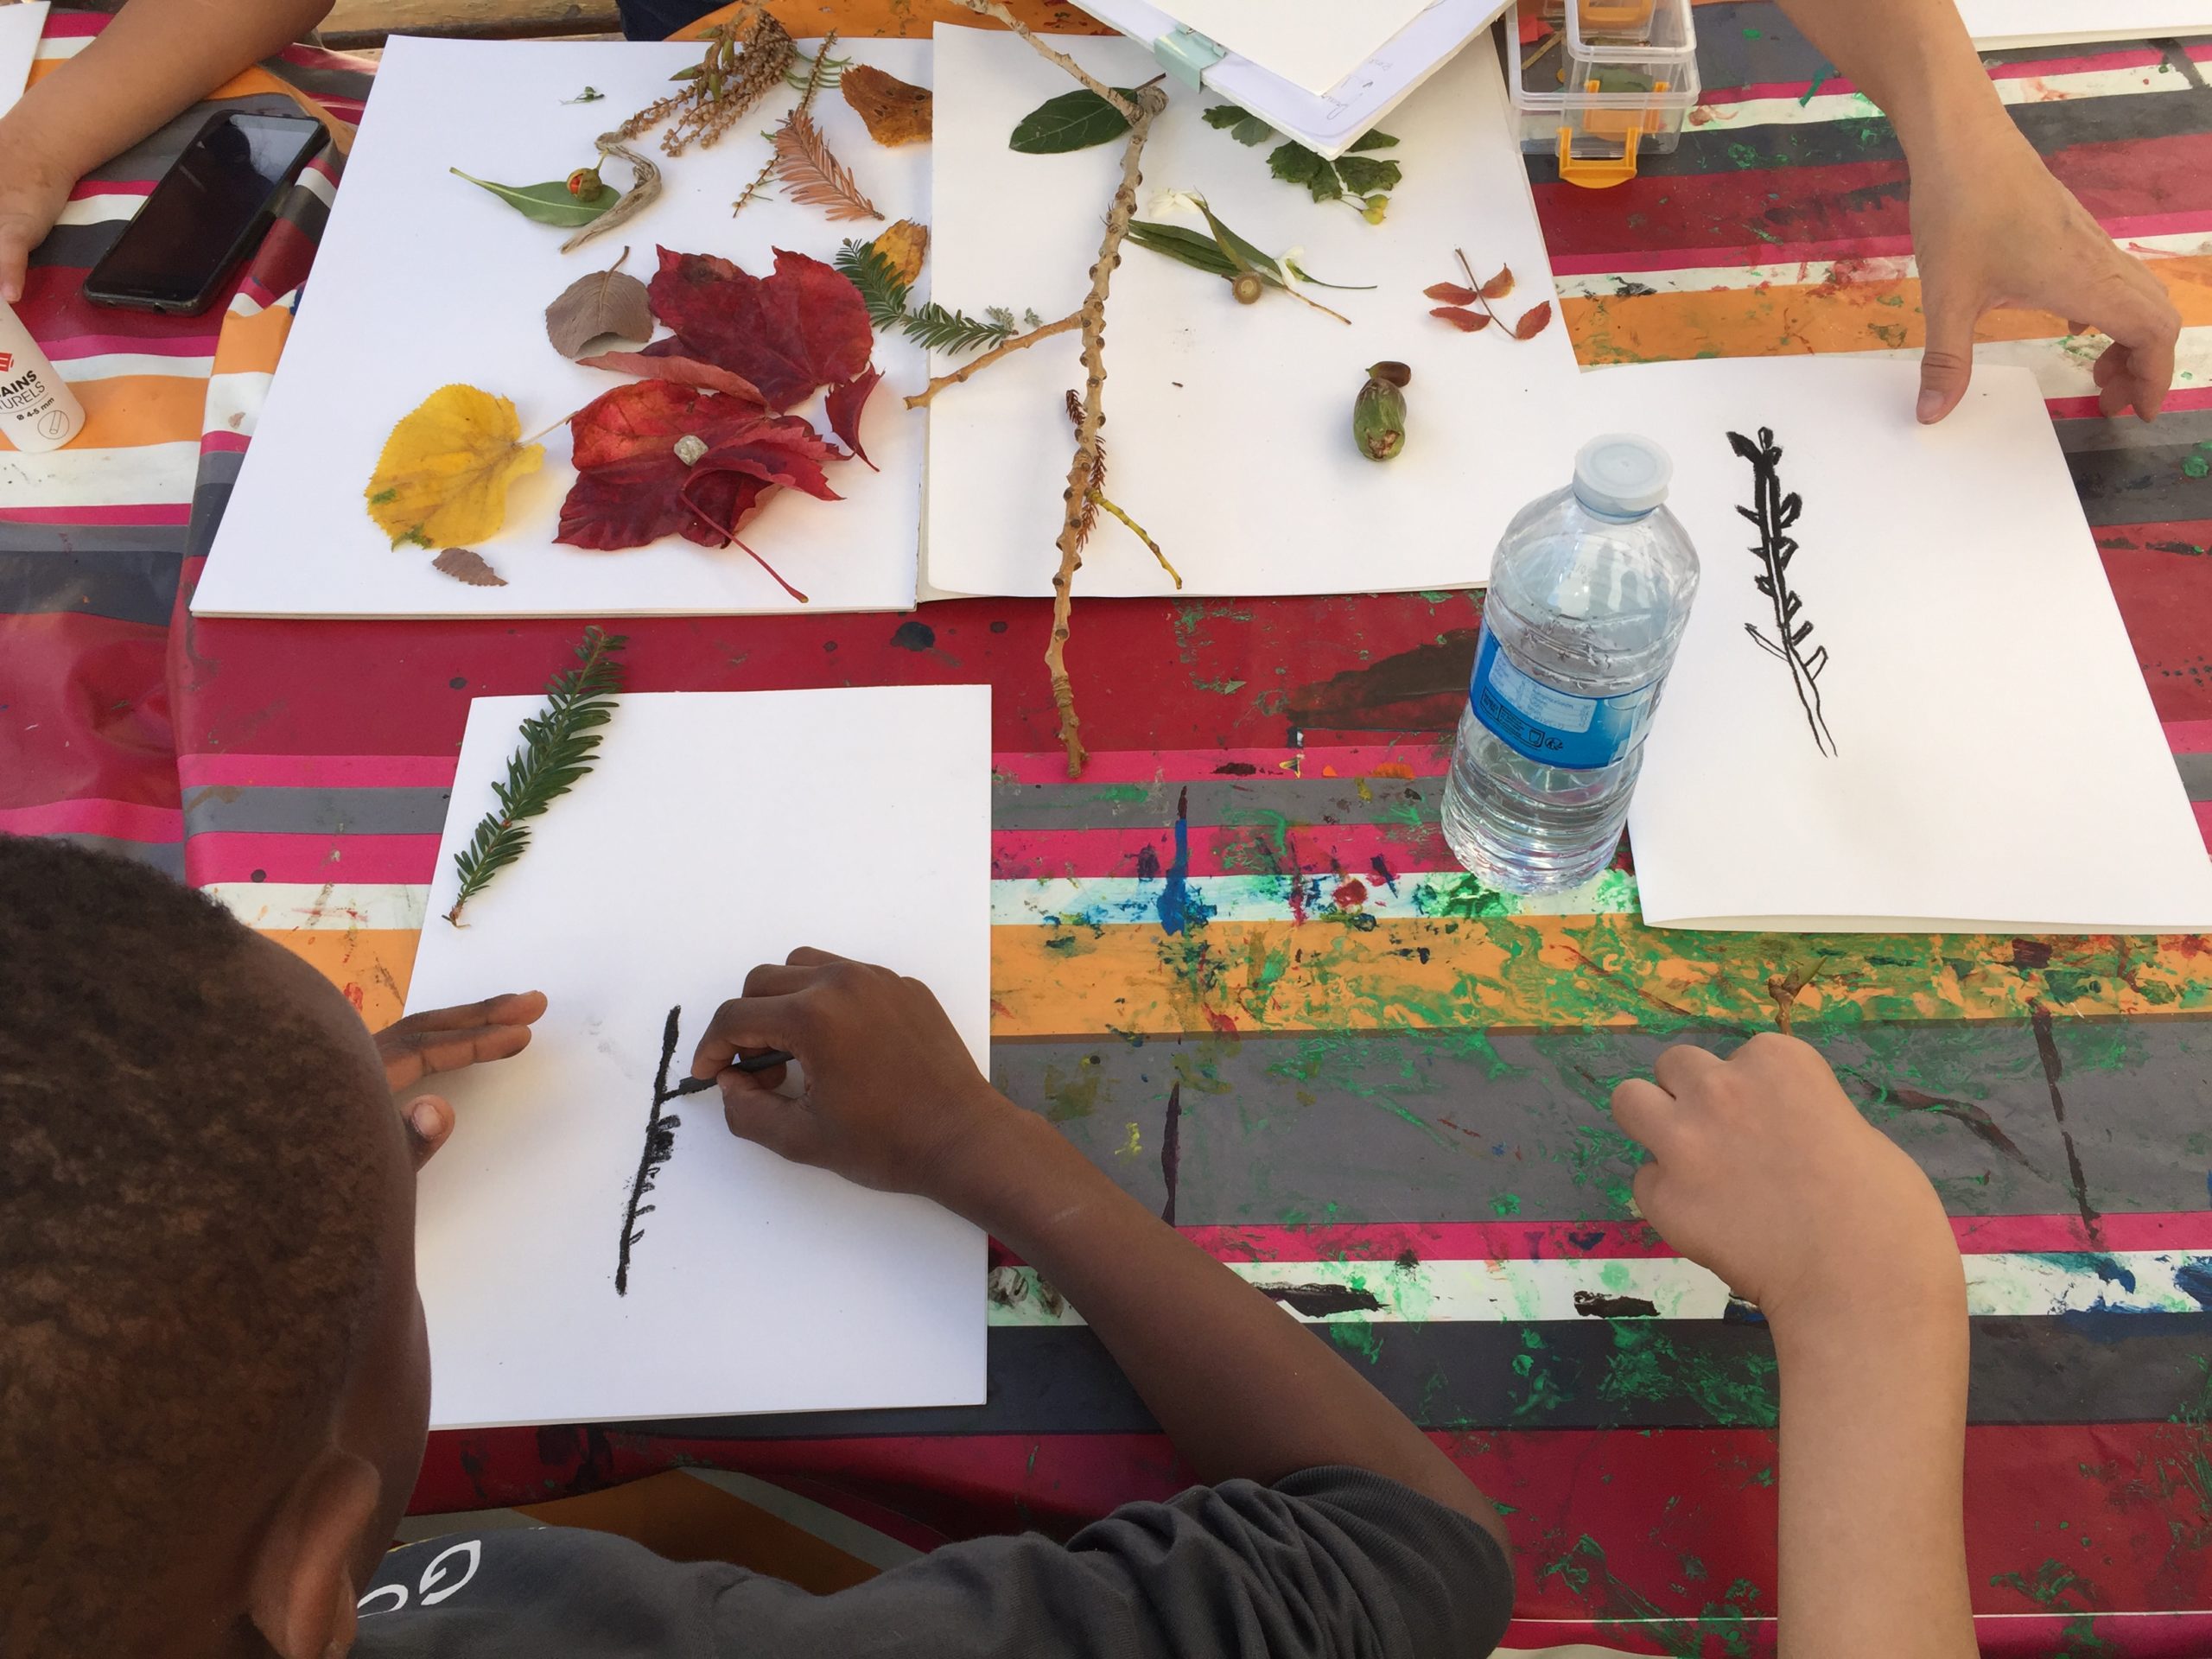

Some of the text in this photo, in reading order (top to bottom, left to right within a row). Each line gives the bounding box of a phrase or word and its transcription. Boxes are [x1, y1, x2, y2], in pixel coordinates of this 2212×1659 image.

[0, 370, 37, 397] AINS
[0, 381, 46, 410] URELS
[27, 408, 40, 417] 4-5
[41, 397, 54, 410] mm
